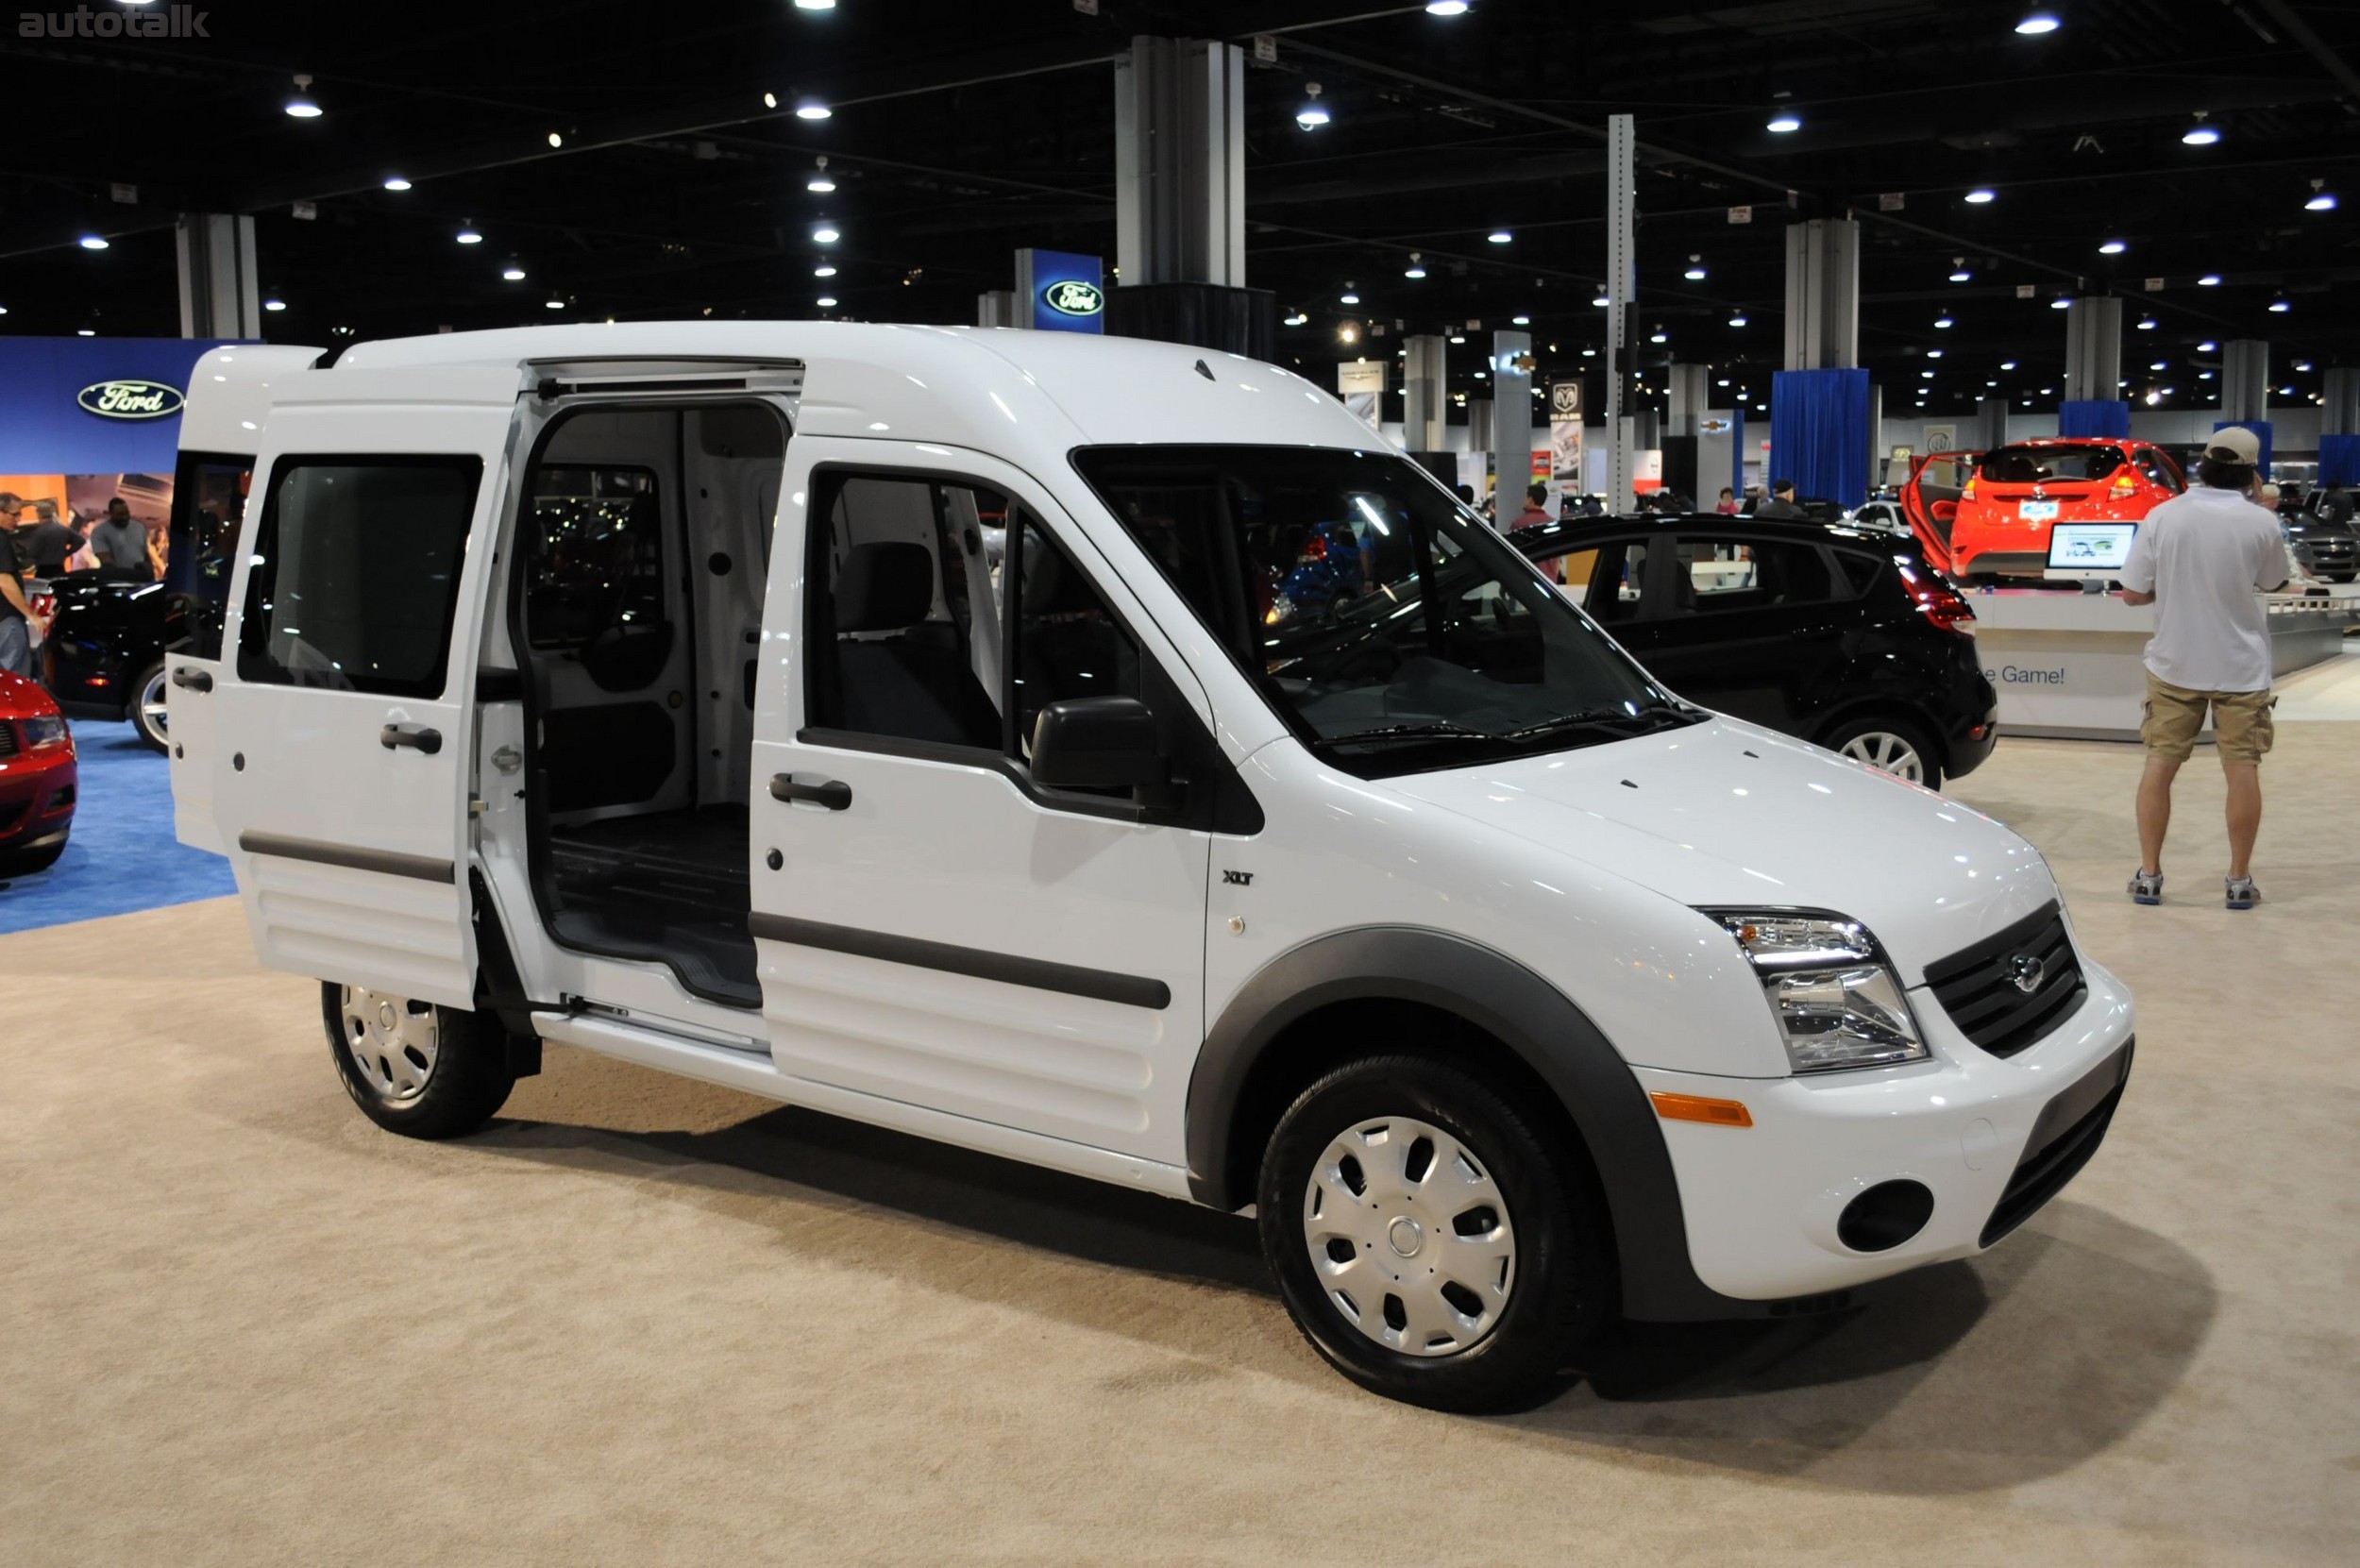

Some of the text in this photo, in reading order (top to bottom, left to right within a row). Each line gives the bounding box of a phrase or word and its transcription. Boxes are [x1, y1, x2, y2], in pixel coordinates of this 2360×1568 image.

[1059, 284, 1096, 311] Ford
[97, 383, 164, 412] Ford
[1549, 413, 1581, 421] RAM
[2001, 665, 2065, 684] Game!
[1222, 868, 1254, 886] XLT
